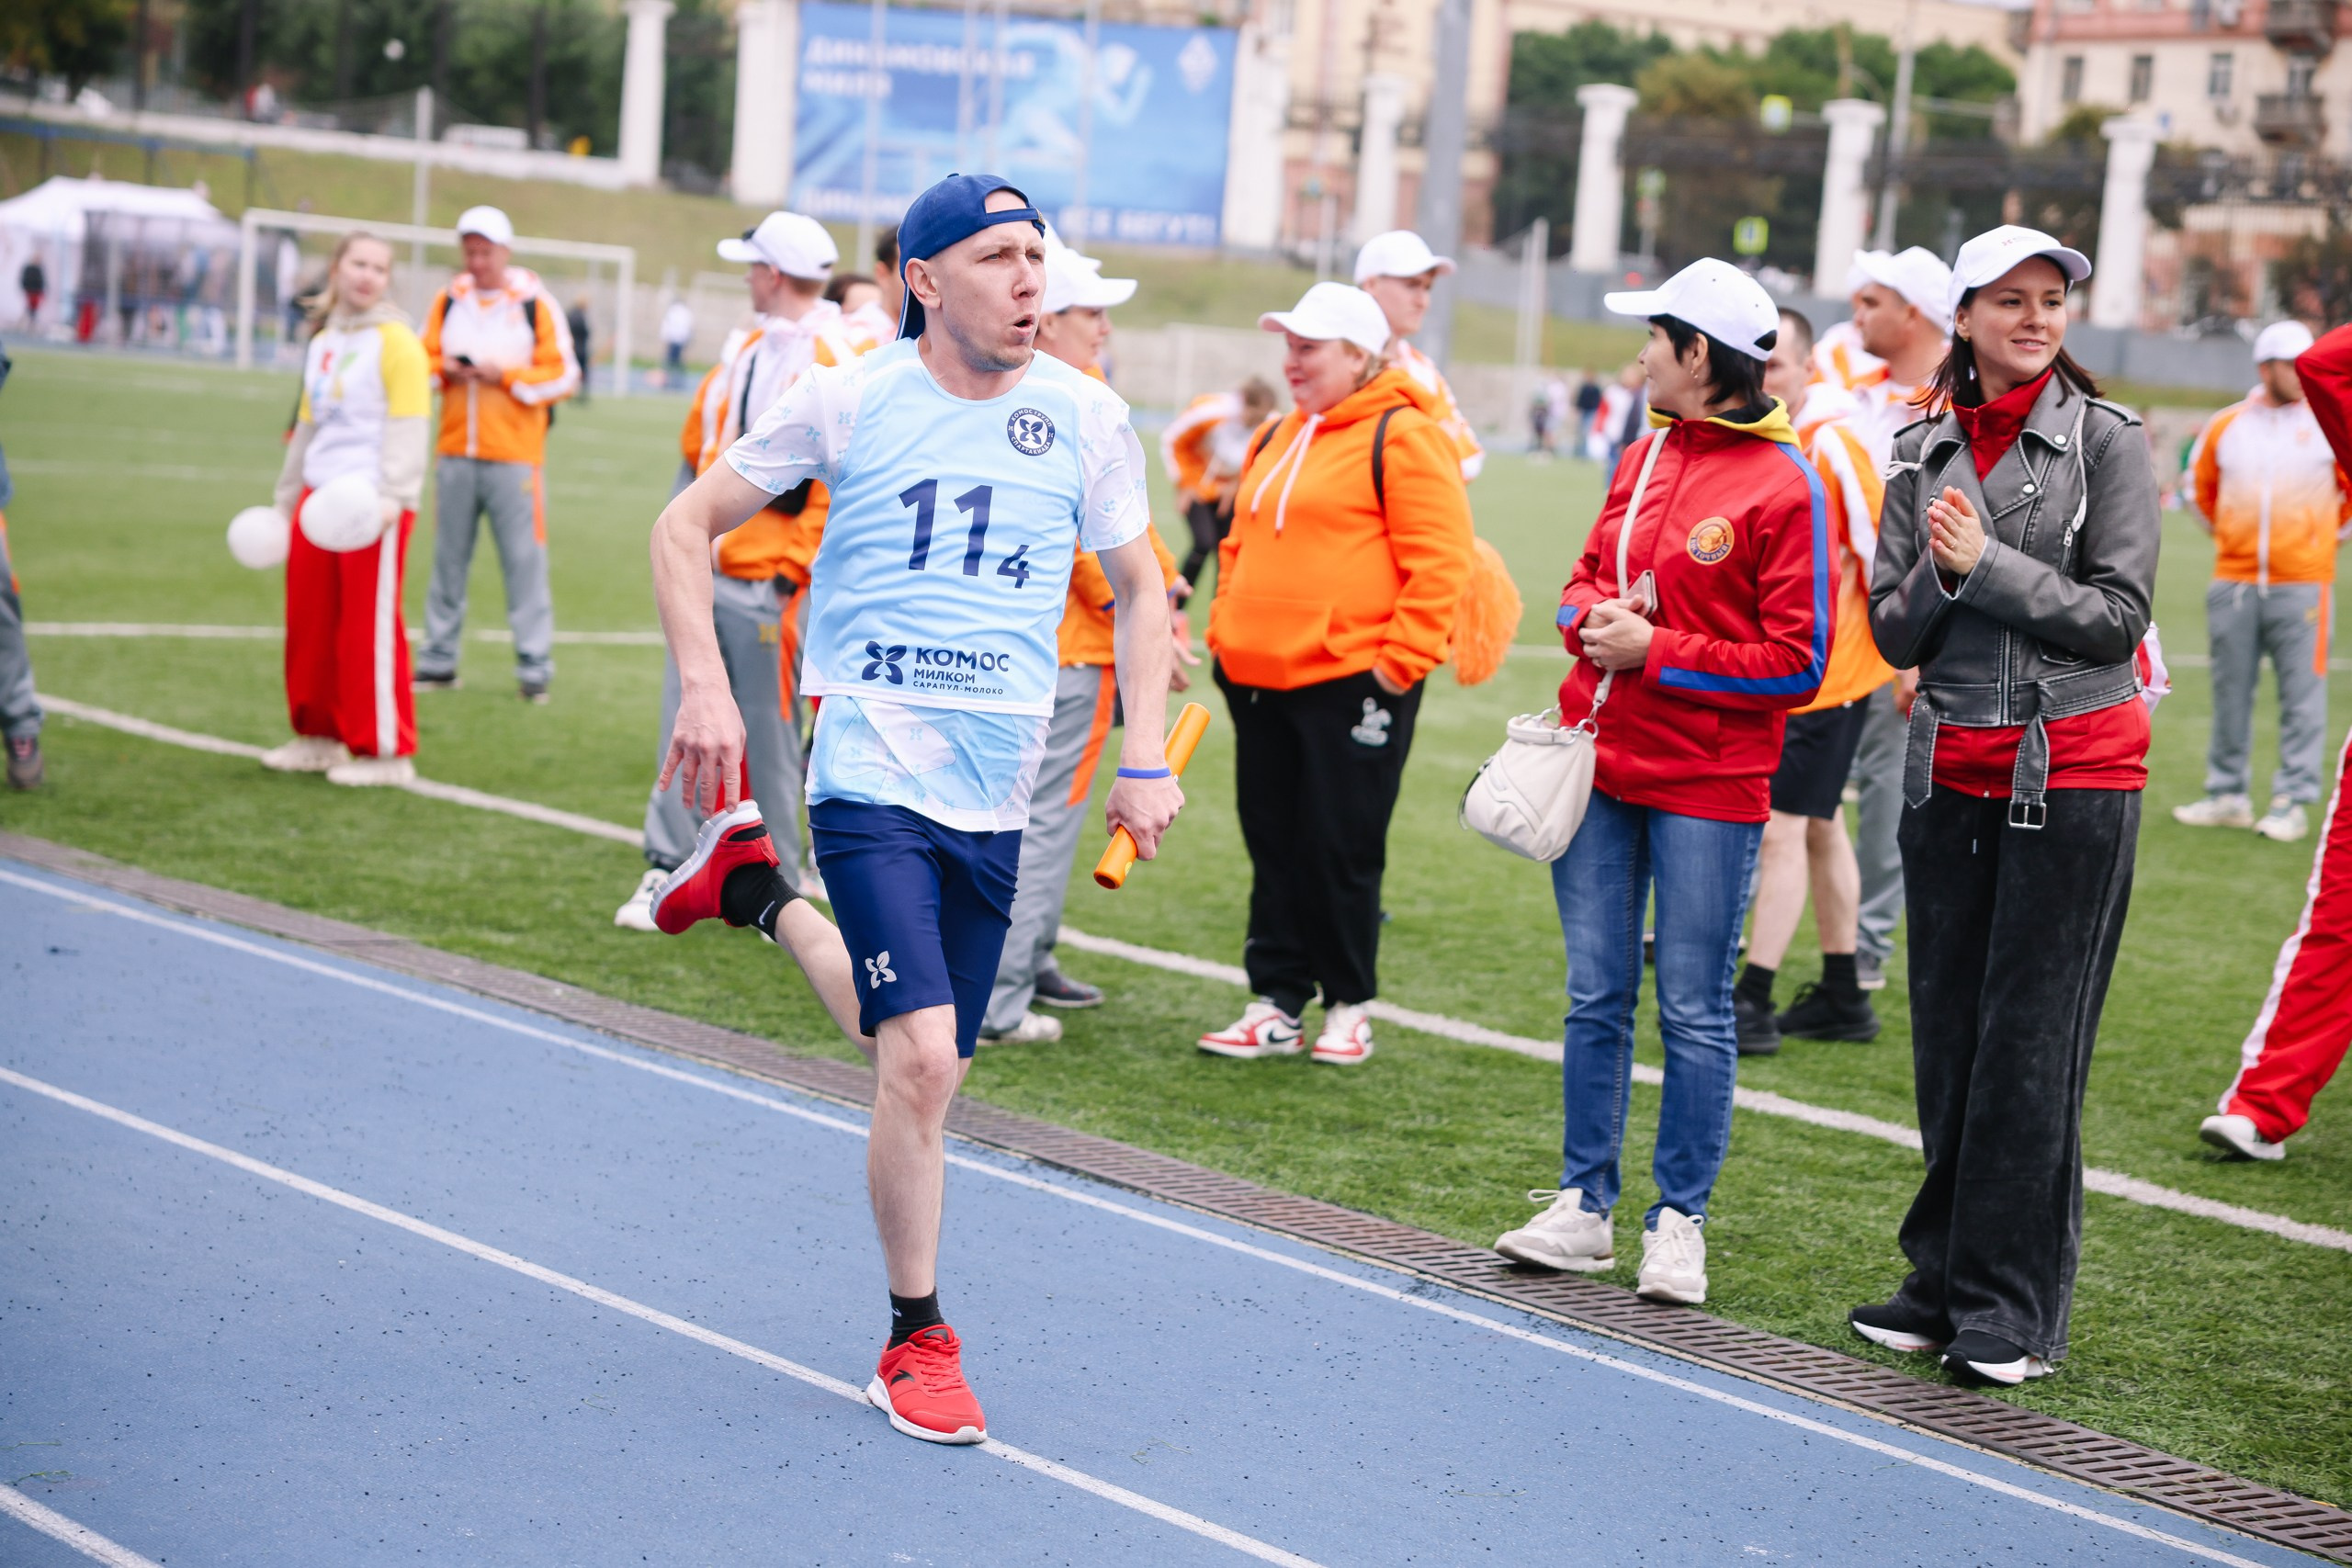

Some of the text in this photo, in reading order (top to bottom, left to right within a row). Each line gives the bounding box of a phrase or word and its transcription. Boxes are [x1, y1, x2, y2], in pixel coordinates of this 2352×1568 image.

[1011, 409, 1053, 427] КОМОС ГРУПП
[1011, 436, 1051, 455] СПАРТАКИАДА
[915, 647, 1010, 672] КОМОС
[913, 668, 976, 683] МИЛКОМ
[912, 681, 1003, 694] САРАПУЛ-МОЛОКО
